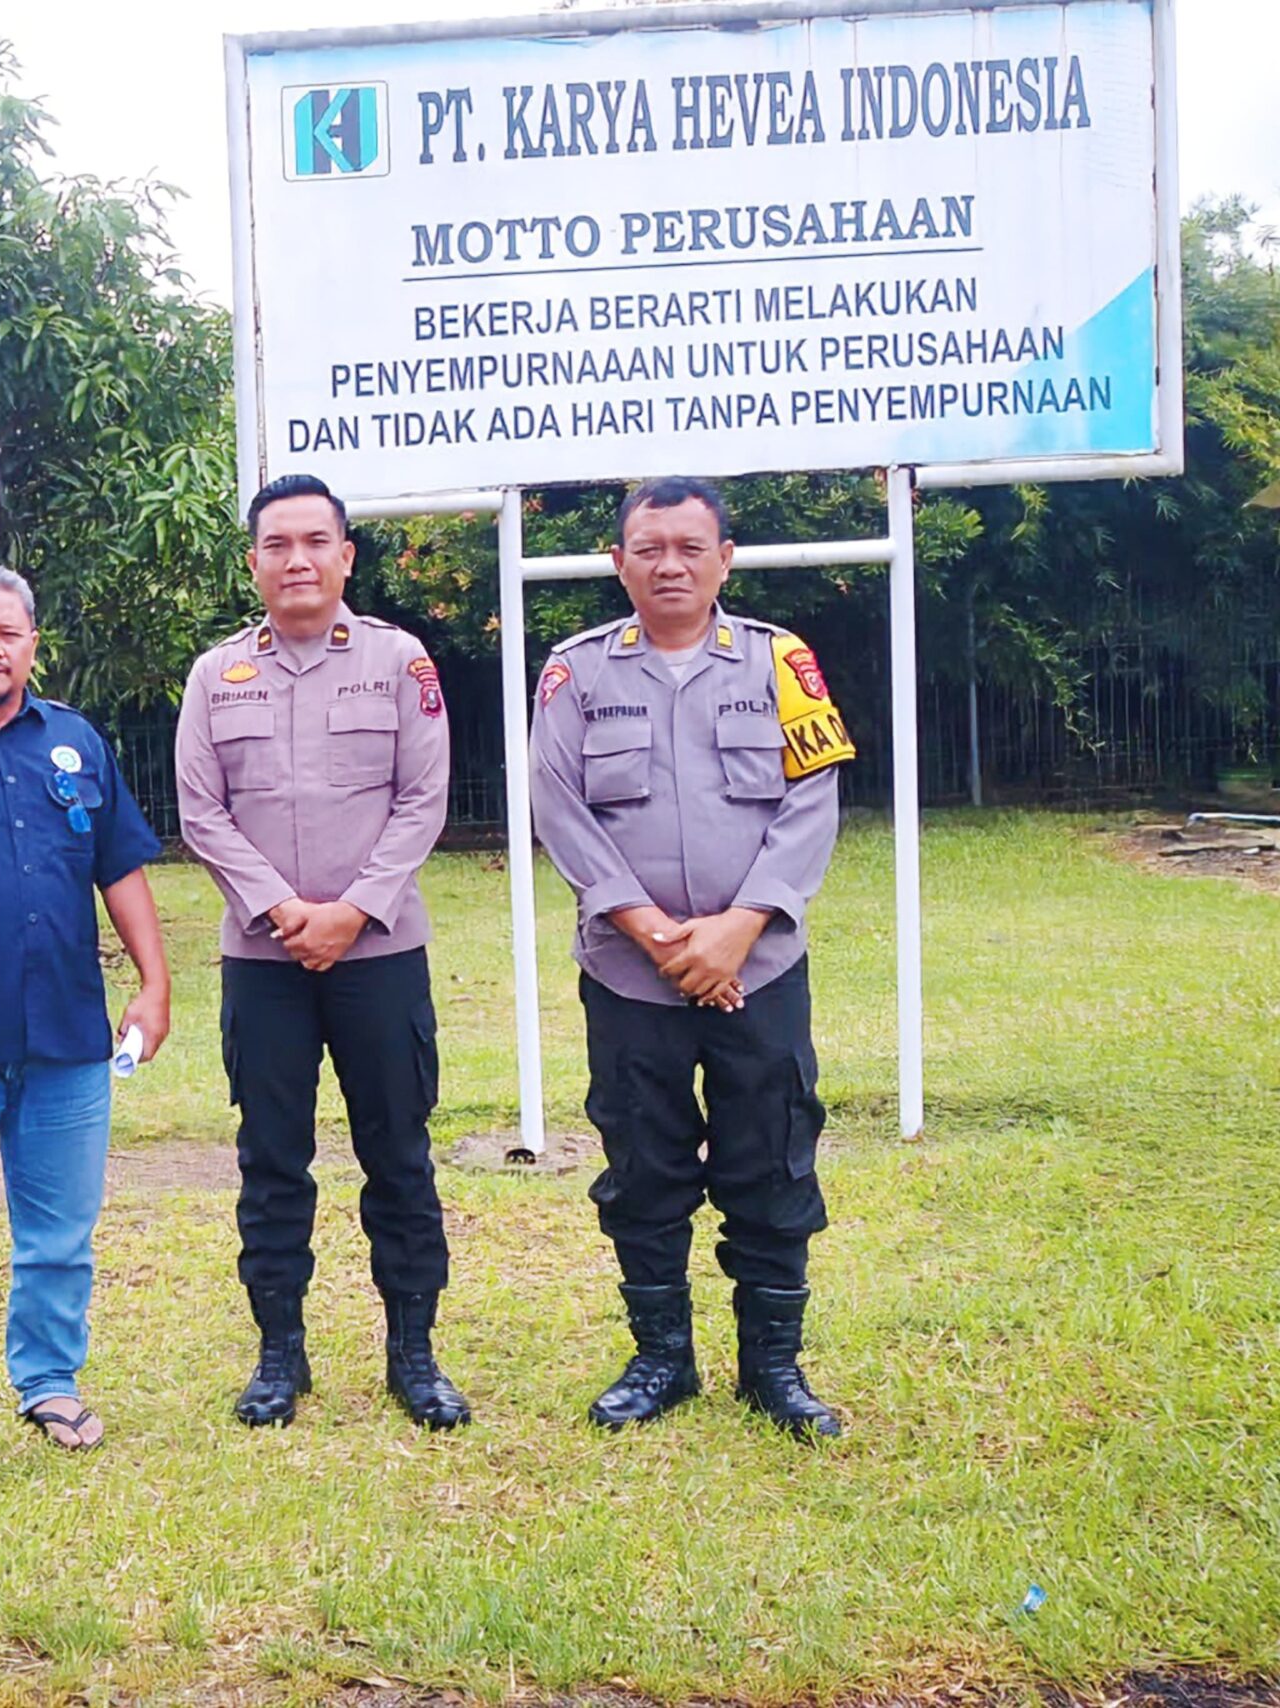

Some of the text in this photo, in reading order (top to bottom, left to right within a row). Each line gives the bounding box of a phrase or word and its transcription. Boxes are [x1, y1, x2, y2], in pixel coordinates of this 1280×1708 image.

[418, 55, 1091, 165] PT. KARYA HEVEA INDONESIA
[411, 195, 976, 267] MOTTO PERUSAHAAN
[415, 277, 977, 341] BEKERJA BERARTI MELAKUKAN
[332, 326, 1064, 398] PENYEMPURNAAAN UNTUK PERUSAHAAN
[289, 376, 1111, 453] DAN TIDAK ADA HARI TANPA PENYEMPURNAAN
[337, 680, 390, 697] POLRI
